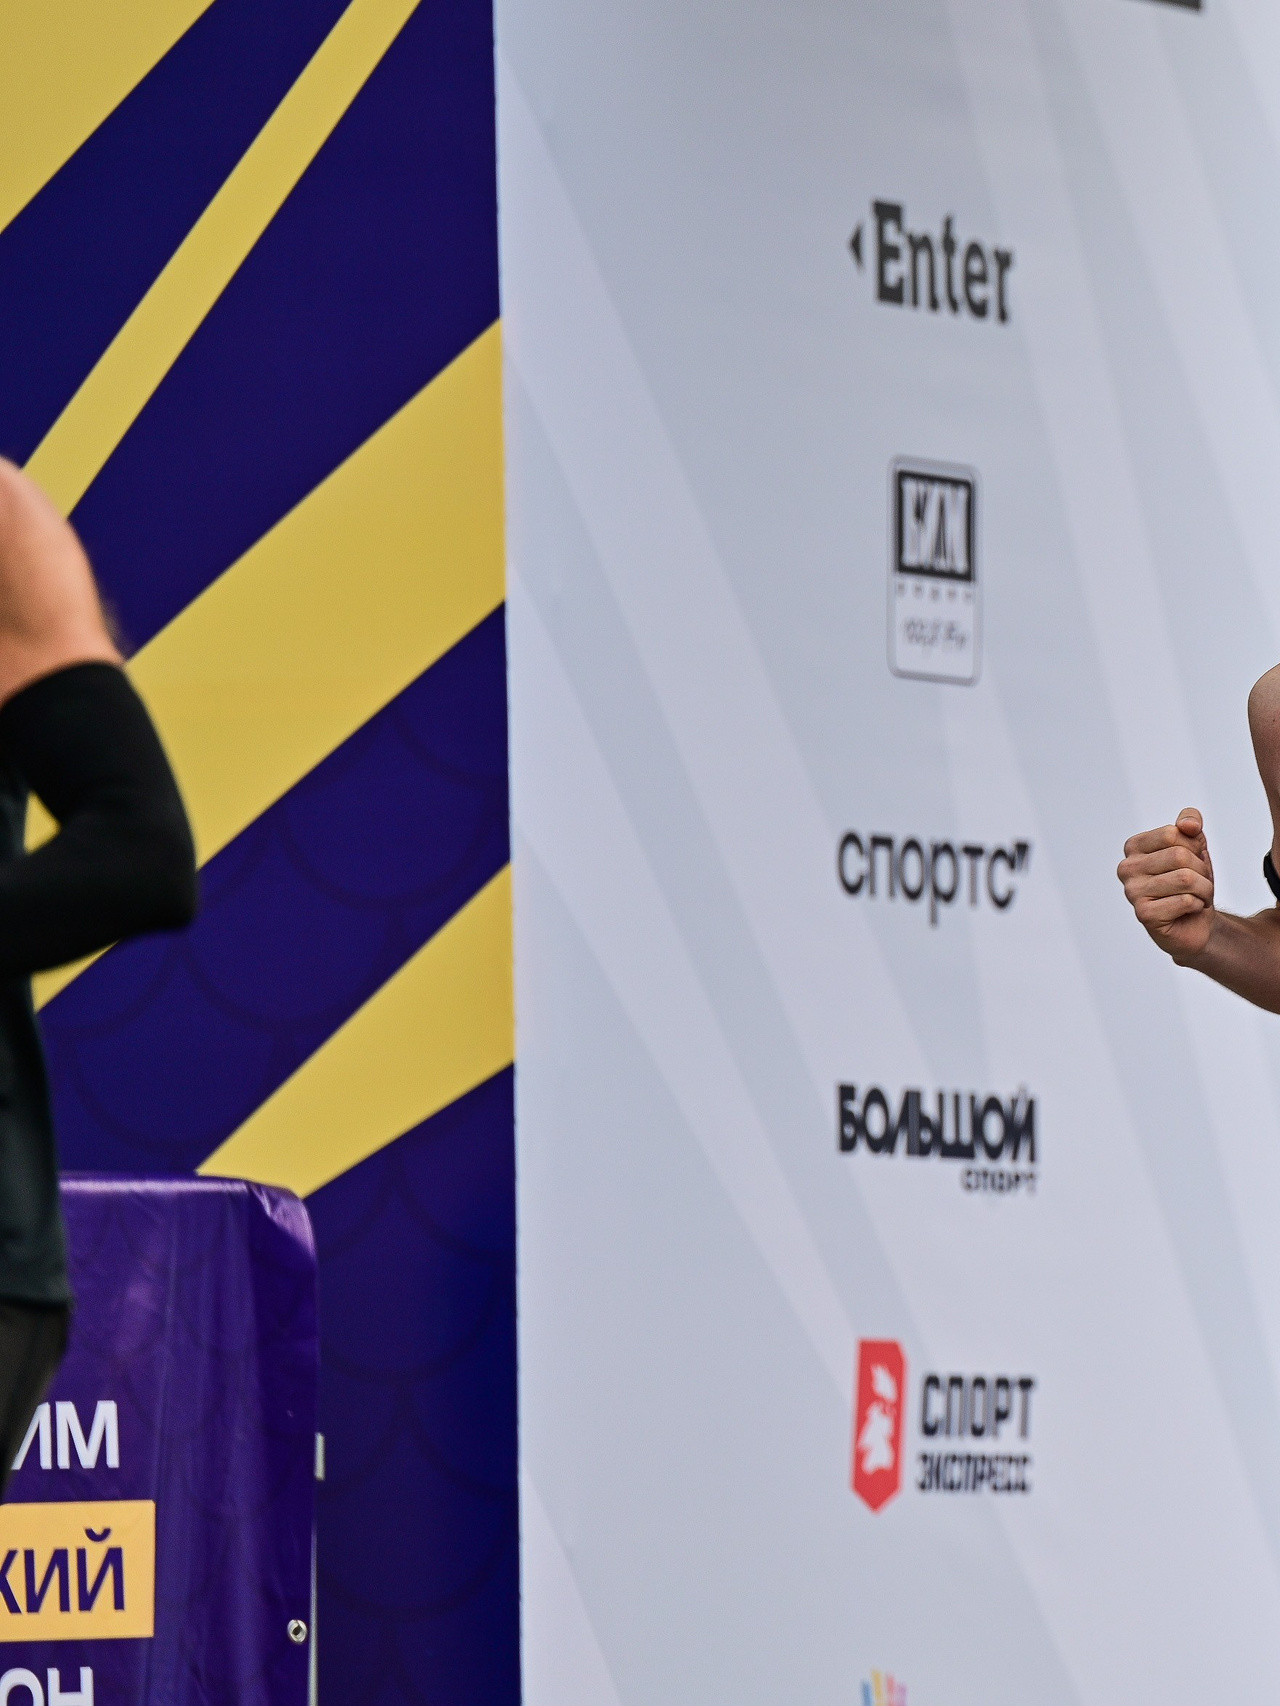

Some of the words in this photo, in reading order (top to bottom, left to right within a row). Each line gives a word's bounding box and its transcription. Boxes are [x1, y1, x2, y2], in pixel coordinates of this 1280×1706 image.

[872, 199, 1013, 325] Enter
[837, 1084, 1037, 1164] БОЛЬШОЙ
[920, 1374, 1035, 1439] СПОРТ
[917, 1452, 1032, 1493] ЭКСПРЕСС
